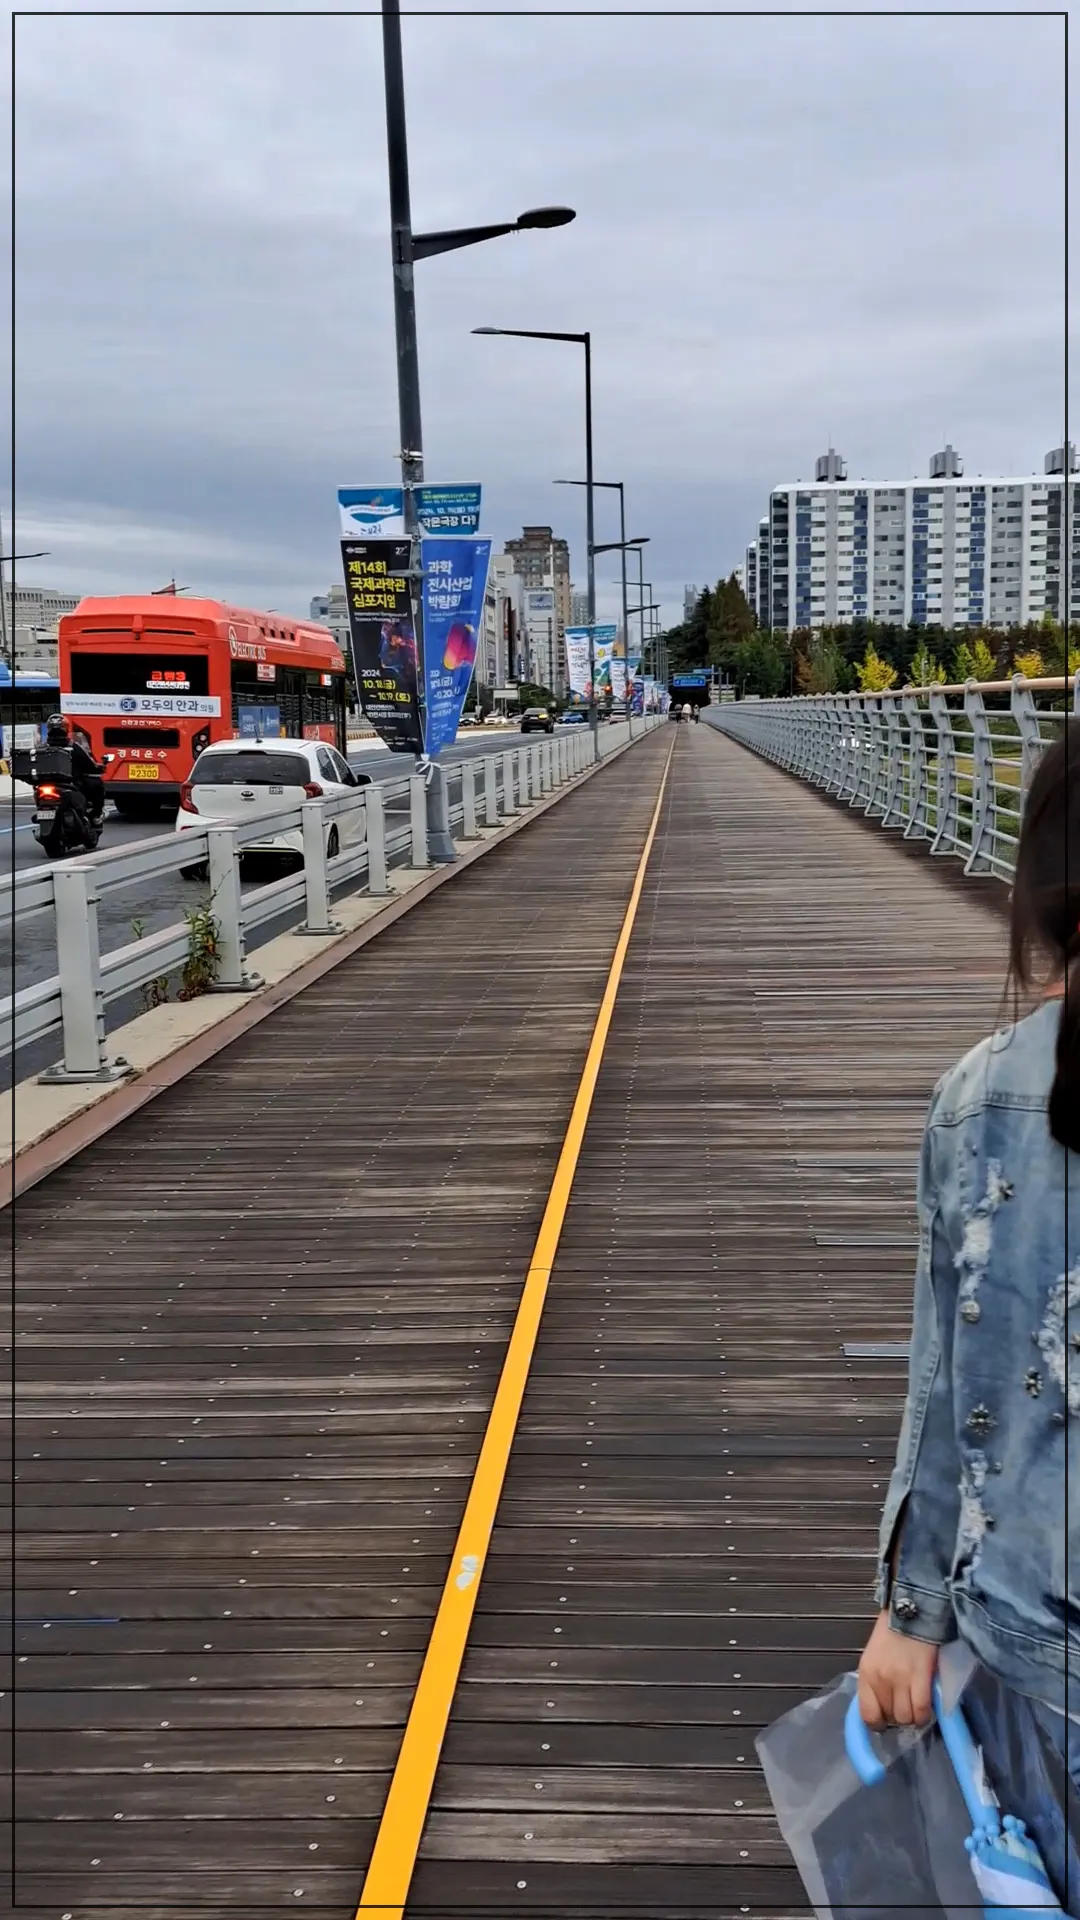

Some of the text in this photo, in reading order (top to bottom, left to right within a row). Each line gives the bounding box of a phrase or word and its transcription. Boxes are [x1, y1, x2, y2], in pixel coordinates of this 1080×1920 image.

[348, 561, 387, 575] 제14회
[428, 560, 453, 575] 과학
[428, 576, 473, 592] 전시산업
[352, 594, 396, 608] 심포지엄
[428, 594, 461, 609] 박람회
[361, 669, 381, 677] 2024
[141, 699, 173, 711] 모두의
[176, 700, 199, 712] 안과
[136, 769, 158, 778] 2300
